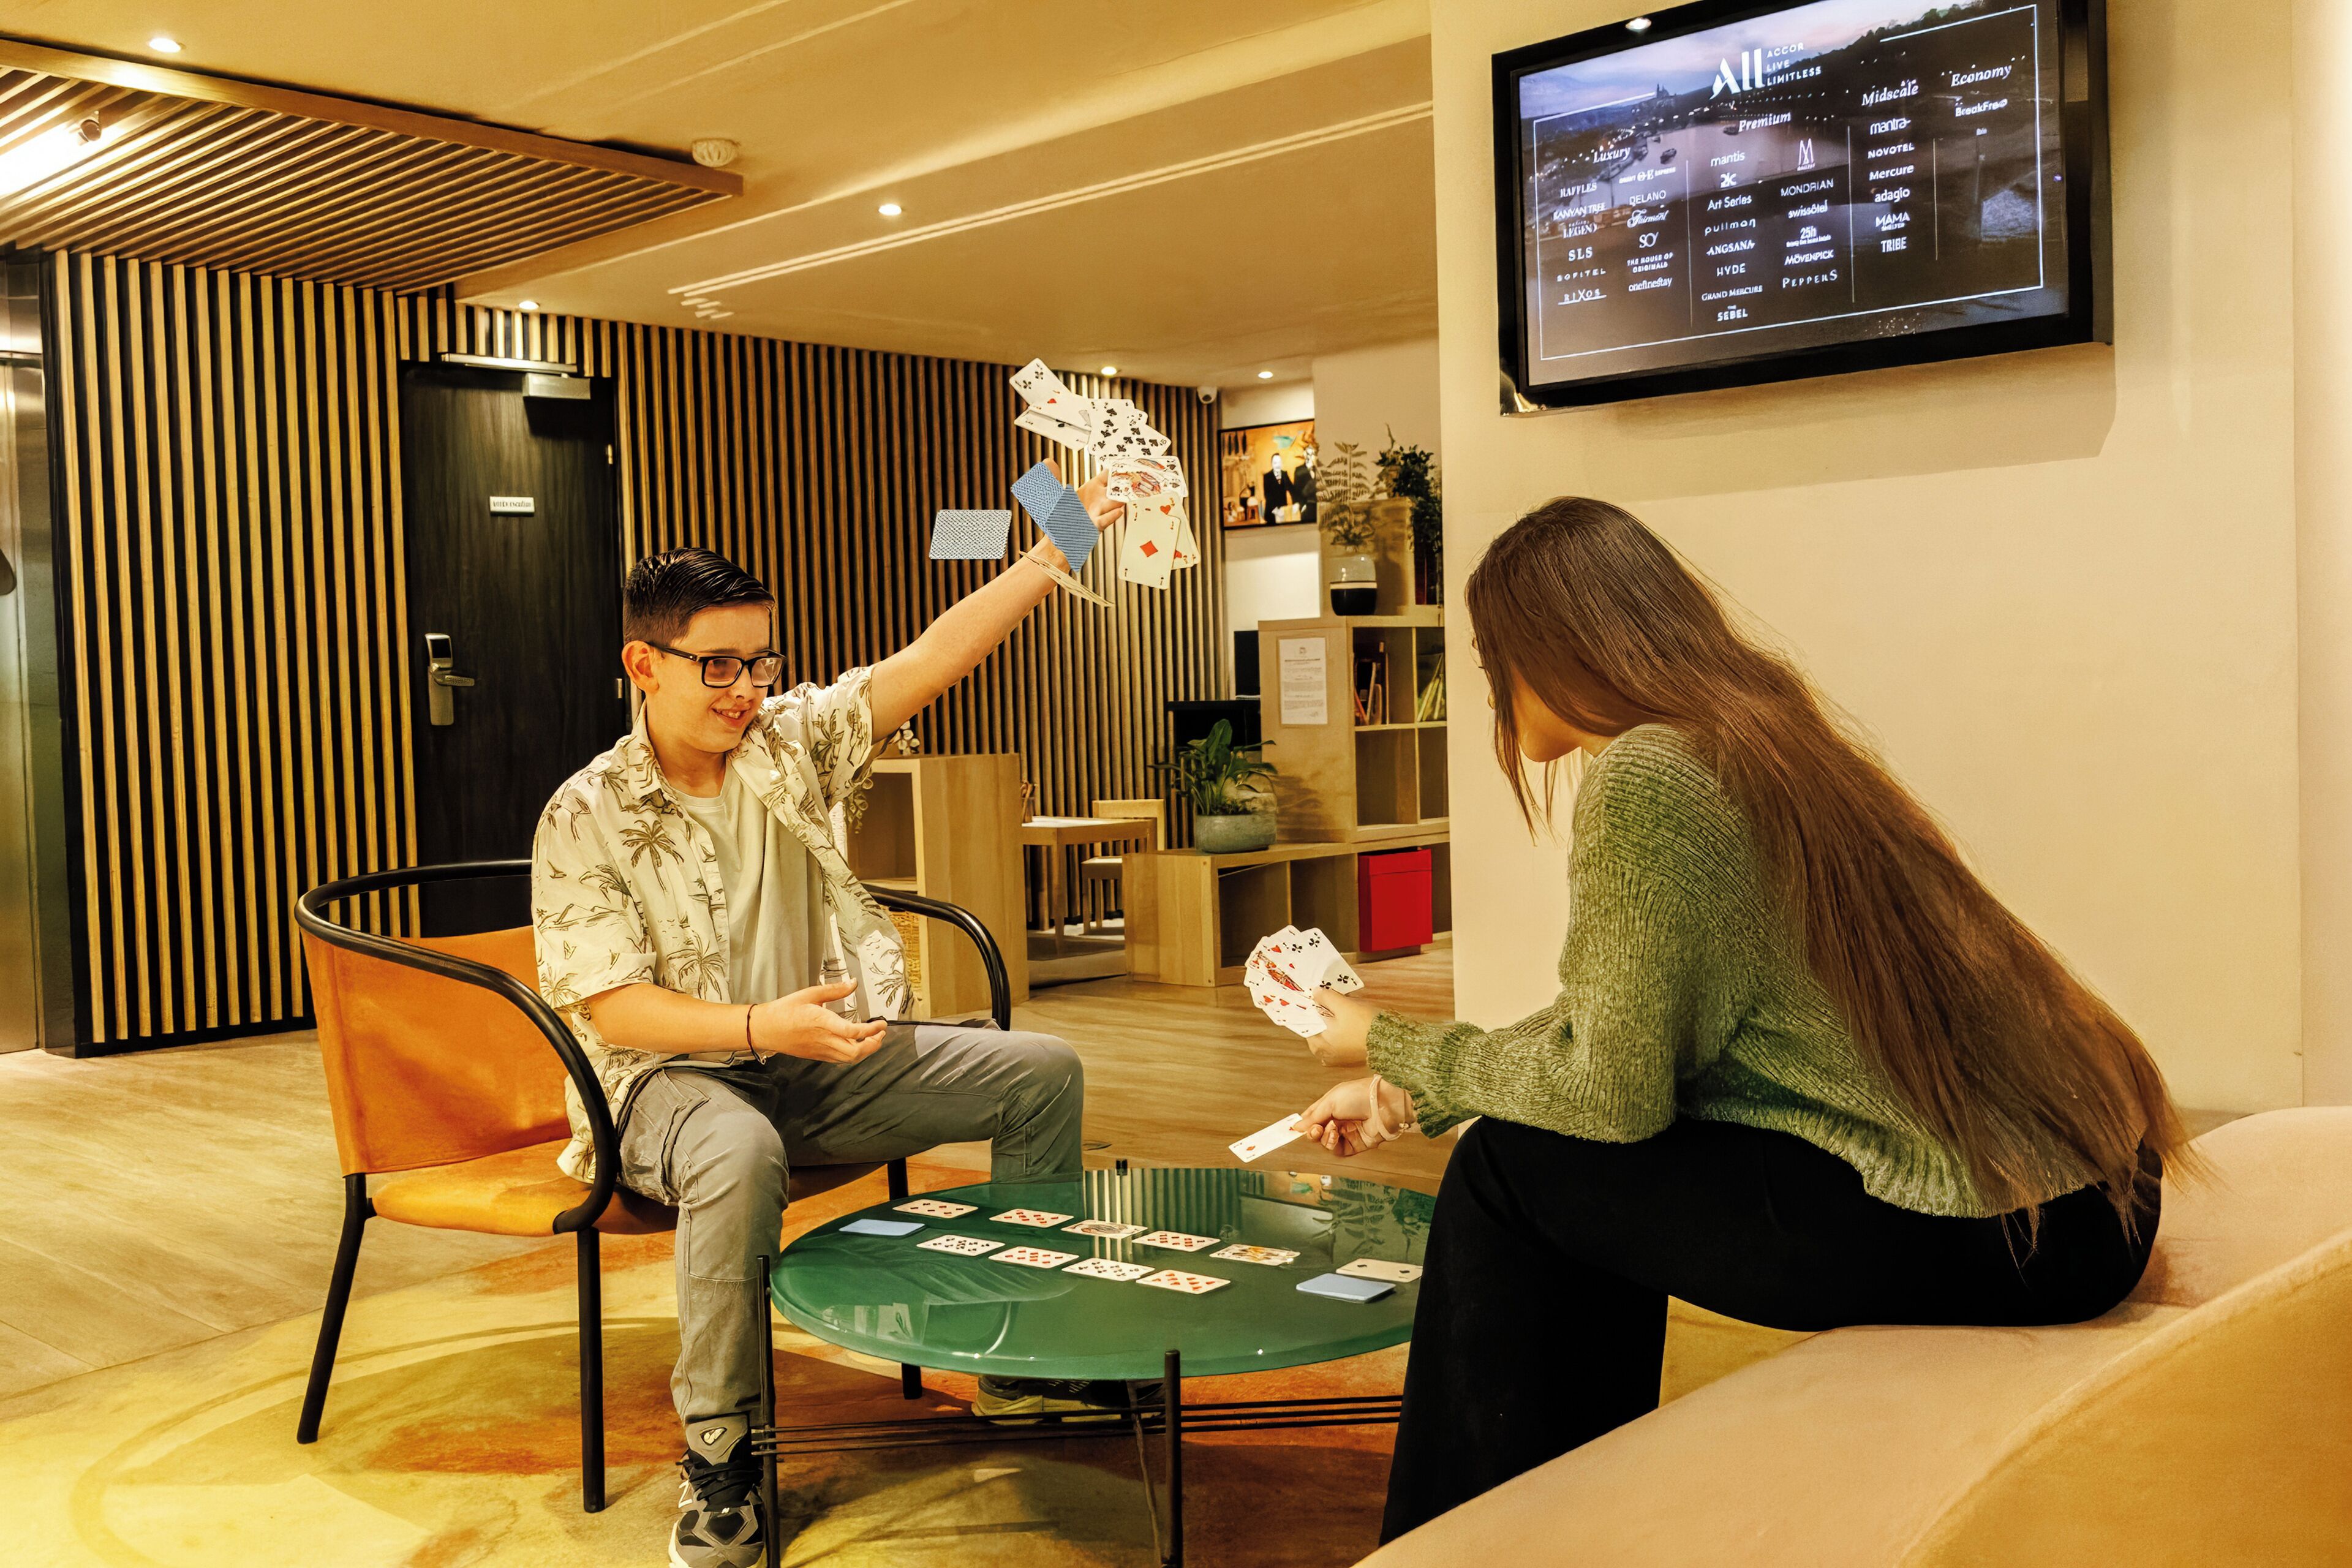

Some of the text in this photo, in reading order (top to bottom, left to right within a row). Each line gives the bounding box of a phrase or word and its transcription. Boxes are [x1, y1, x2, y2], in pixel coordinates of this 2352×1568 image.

[1766, 42, 1804, 58] ACCOR
[1766, 59, 1790, 72] LIVE
[1766, 66, 1822, 86] LIMITLESS
[1951, 64, 2012, 87] Economy
[1861, 81, 1920, 107] Midscale
[1738, 112, 1792, 132] Premium
[1870, 118, 1911, 135] mantra
[1593, 147, 1631, 164] Luxury
[1710, 151, 1746, 167] mantis
[1868, 143, 1915, 159] NOVOTEL
[1869, 165, 1914, 181] Mercure
[1781, 178, 1834, 197] MONDRIAN
[1874, 187, 1910, 202] adagio
[1629, 190, 1667, 206] DELANO
[1707, 195, 1752, 211] Art Series
[1875, 211, 1910, 227] MAMA
[1705, 219, 1756, 236] pullman
[1706, 239, 1755, 256] ANGSANA
[1880, 236, 1907, 253] TRIBE
[1568, 247, 1593, 262] SLS
[1557, 268, 1607, 282] SOFITEL
[1717, 263, 1746, 276] HYDE
[1717, 309, 1748, 322] SEBEL
